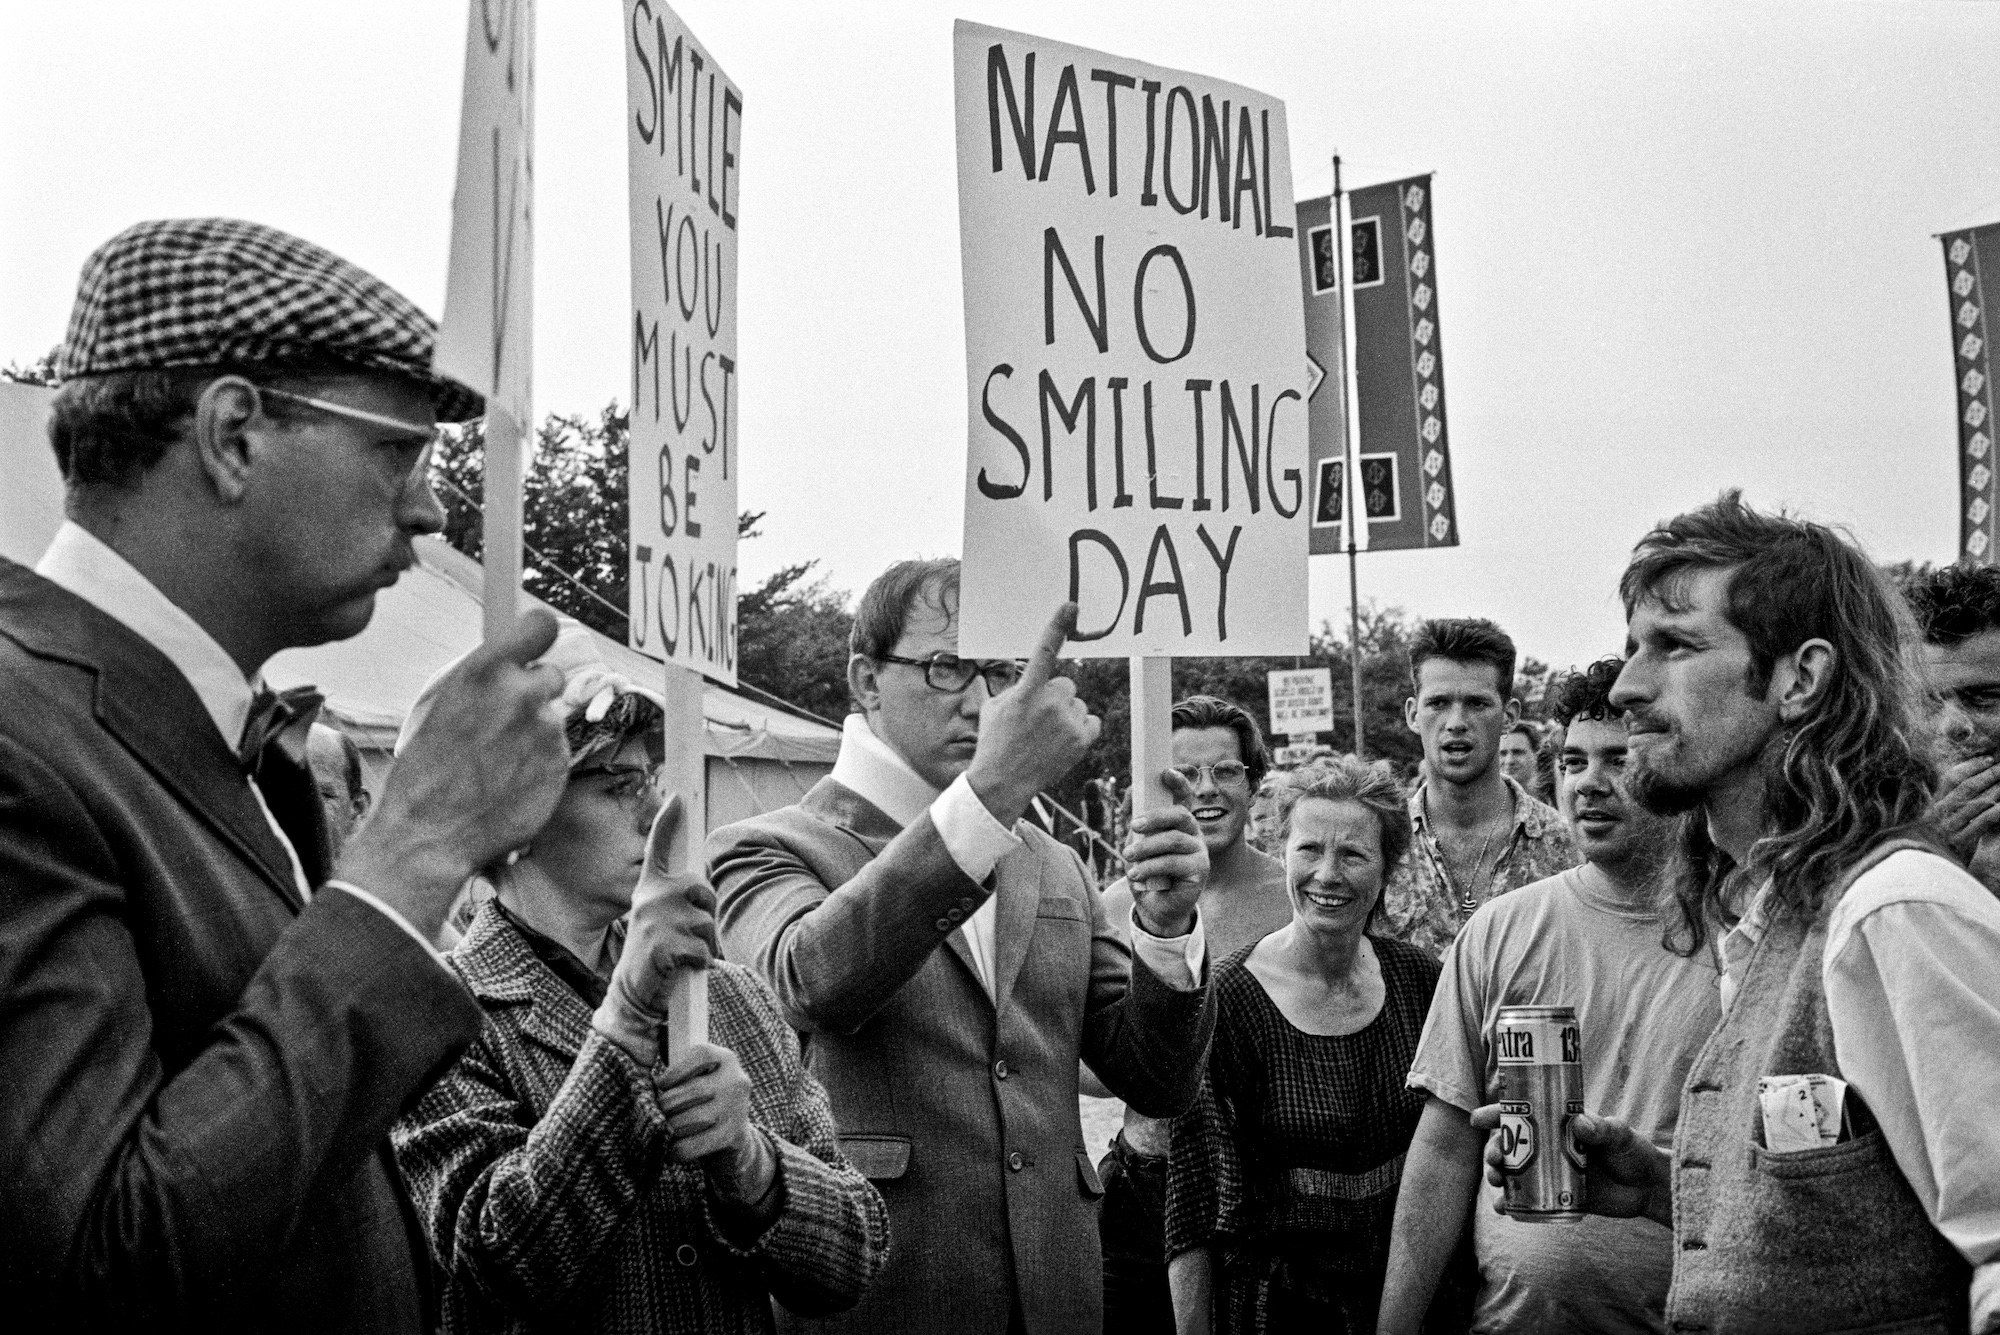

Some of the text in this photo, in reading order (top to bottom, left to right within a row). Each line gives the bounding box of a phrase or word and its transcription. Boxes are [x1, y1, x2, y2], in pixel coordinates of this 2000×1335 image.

[632, 0, 742, 232] SMILE
[987, 43, 1293, 239] NATIONAL
[656, 195, 721, 340] YOU
[1043, 226, 1196, 364] NO
[635, 309, 735, 481] MUST
[977, 363, 1303, 519] SMILING
[658, 443, 701, 539] BE
[633, 544, 738, 672] JOKING
[1067, 523, 1243, 642] DAY
